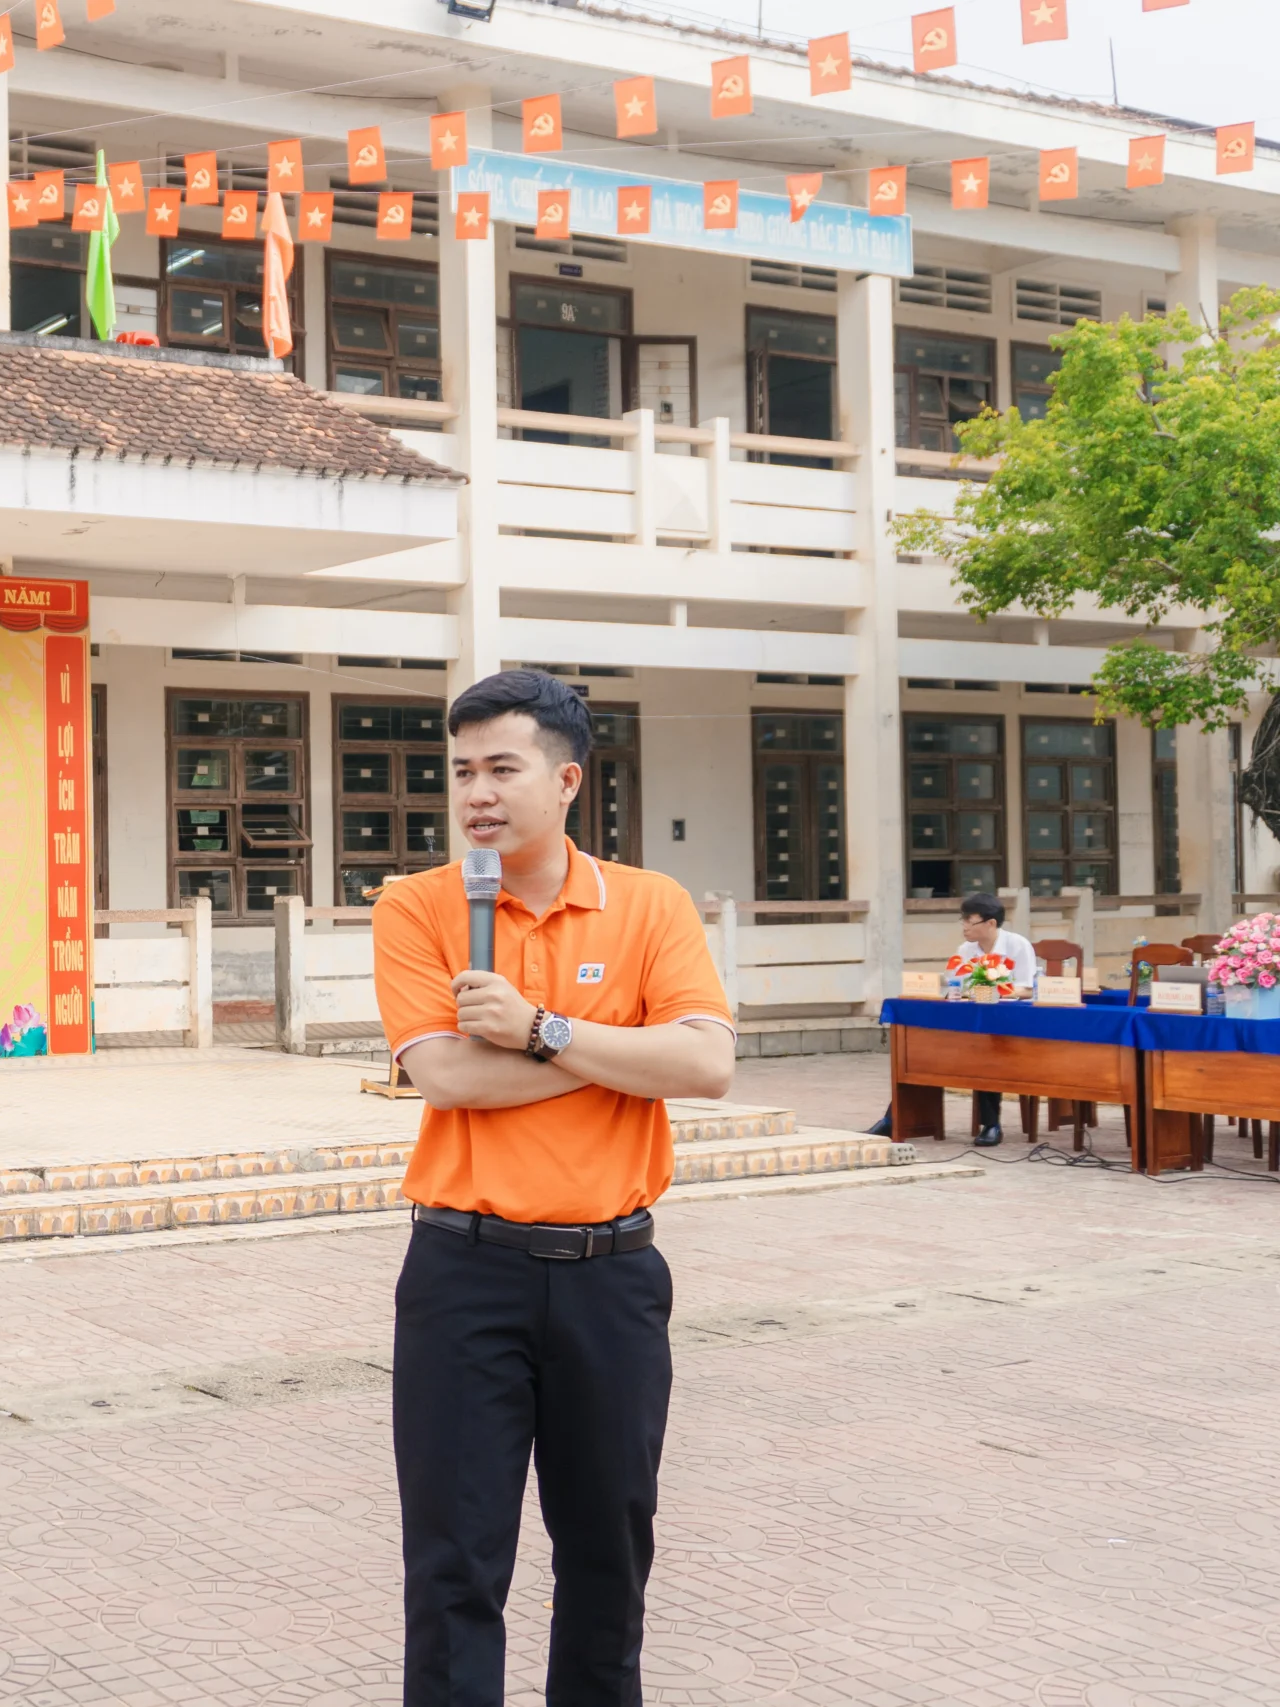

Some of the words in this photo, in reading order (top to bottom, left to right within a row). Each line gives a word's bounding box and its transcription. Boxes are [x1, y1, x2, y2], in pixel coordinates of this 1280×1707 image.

[4, 587, 51, 607] NĂM!
[60, 663, 70, 704] VÌ
[58, 720, 74, 765] LỢI
[58, 770, 75, 811] ÍCH
[53, 826, 80, 864] TRĂM
[57, 880, 78, 918] NĂM
[53, 926, 84, 972] TRỒNG
[55, 985, 83, 1026] NGƯỜI
